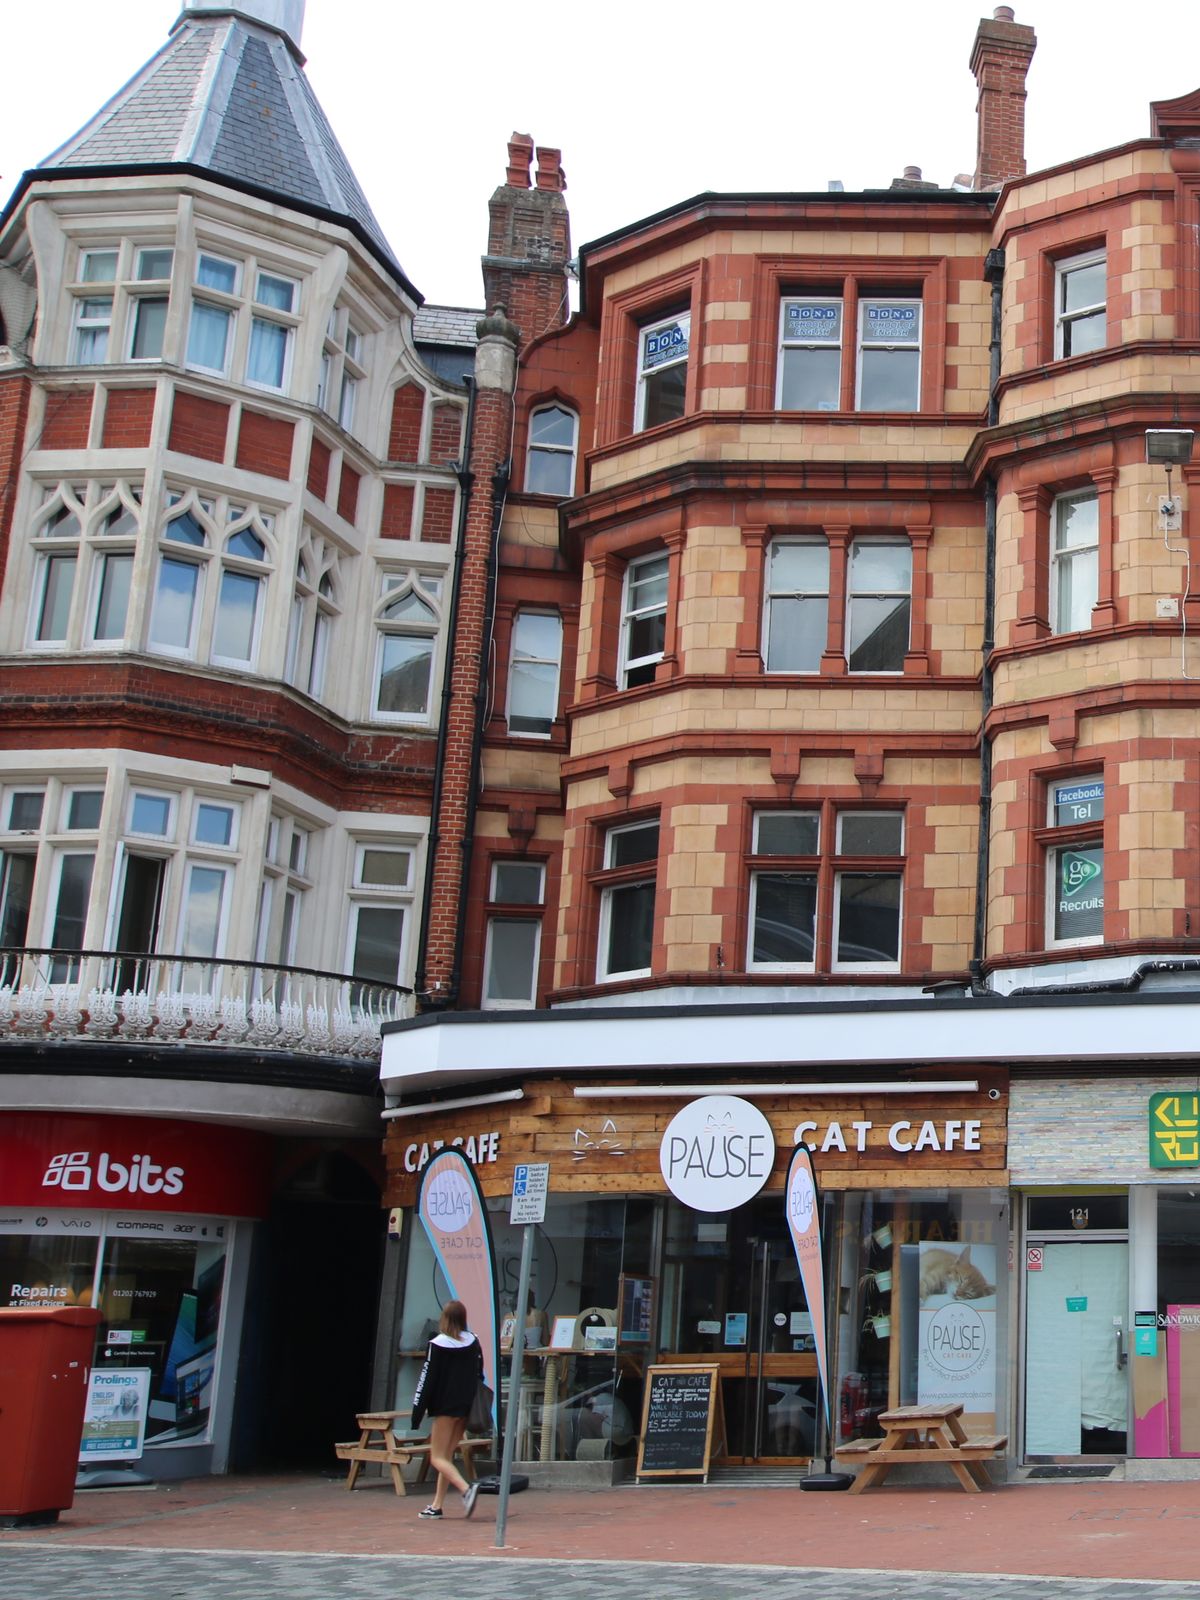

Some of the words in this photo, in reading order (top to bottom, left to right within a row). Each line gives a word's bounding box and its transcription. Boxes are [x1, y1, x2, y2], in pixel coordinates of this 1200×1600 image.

[1057, 785, 1102, 802] facebook
[1070, 803, 1092, 819] Tel
[1059, 897, 1105, 913] Recruits
[794, 1120, 873, 1153] CAT
[887, 1119, 982, 1153] CAFE
[452, 1131, 500, 1164] AFE
[669, 1135, 765, 1179] PAUSE
[97, 1152, 185, 1195] bits
[1069, 1208, 1089, 1220] 121
[60, 1219, 92, 1228] VAIO
[116, 1221, 164, 1231] COMPAQ
[173, 1224, 196, 1233] acer
[11, 1284, 68, 1300] Repairs
[19, 1299, 41, 1307] Fixed
[932, 1325, 981, 1351] PAUSE
[94, 1374, 139, 1386] Prolingo
